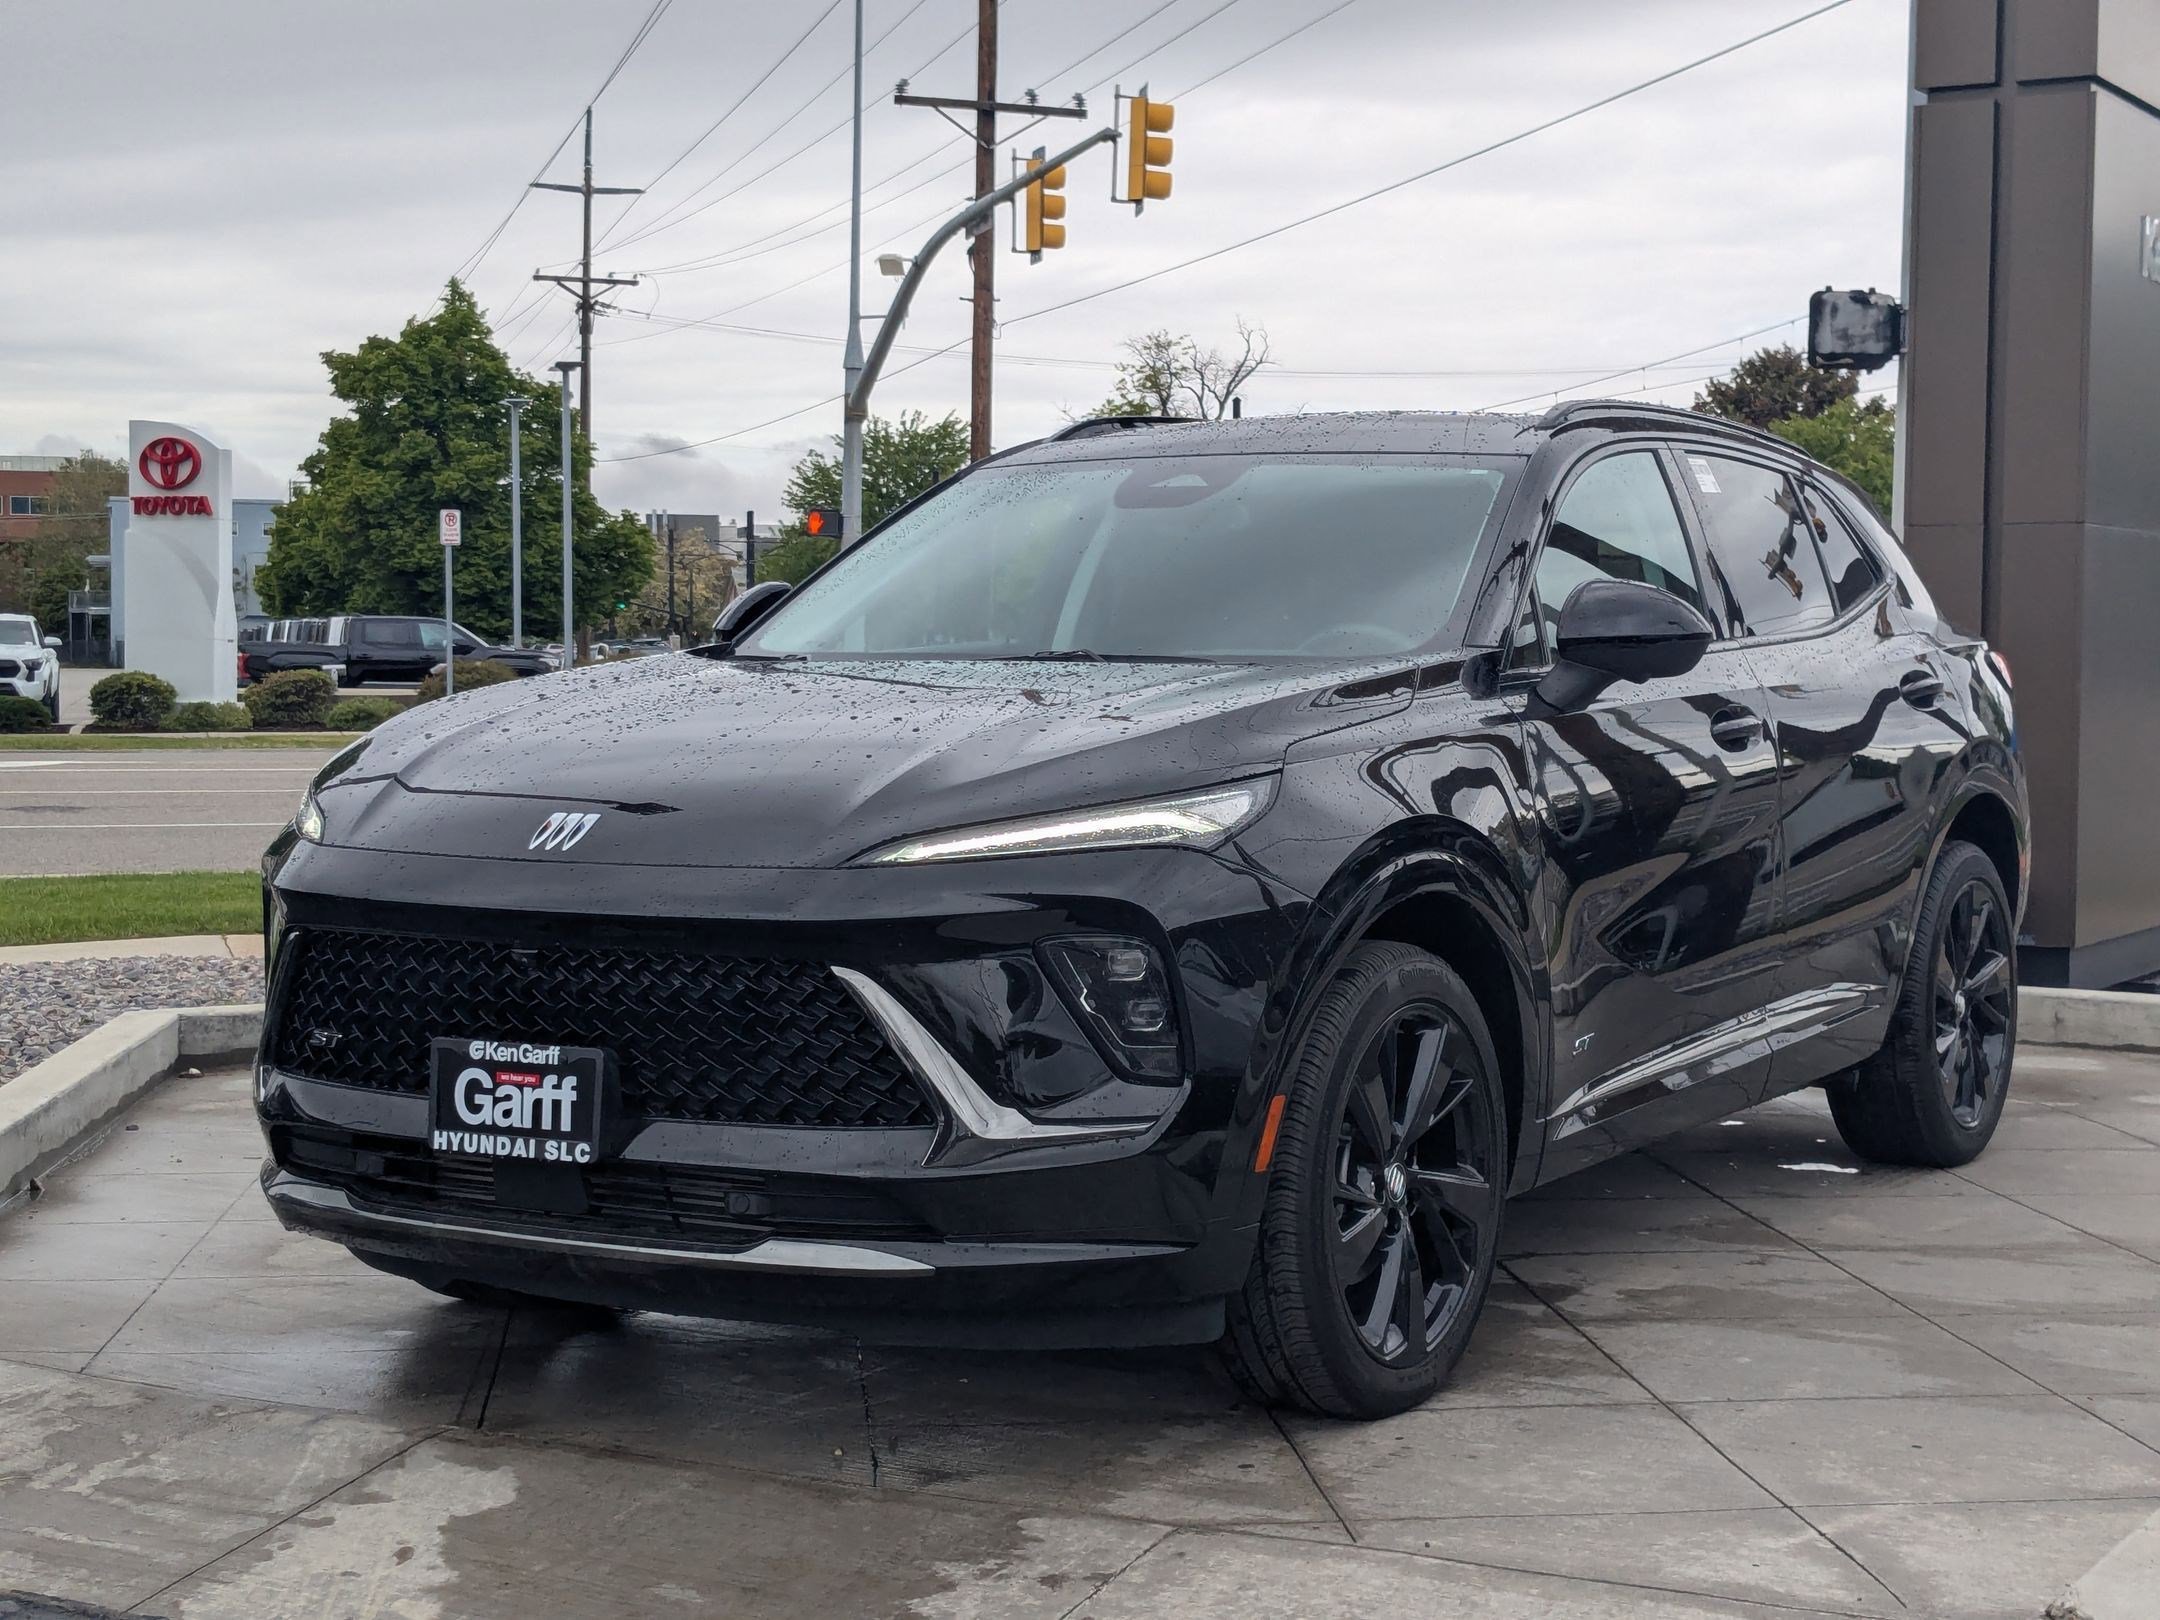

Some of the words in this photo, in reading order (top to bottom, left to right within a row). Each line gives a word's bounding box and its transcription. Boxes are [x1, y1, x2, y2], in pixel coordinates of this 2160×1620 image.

[130, 495, 213, 516] TOYOTA
[454, 1067, 577, 1132] Garff
[433, 1130, 536, 1159] HYUNDAI
[544, 1139, 591, 1164] SLC
